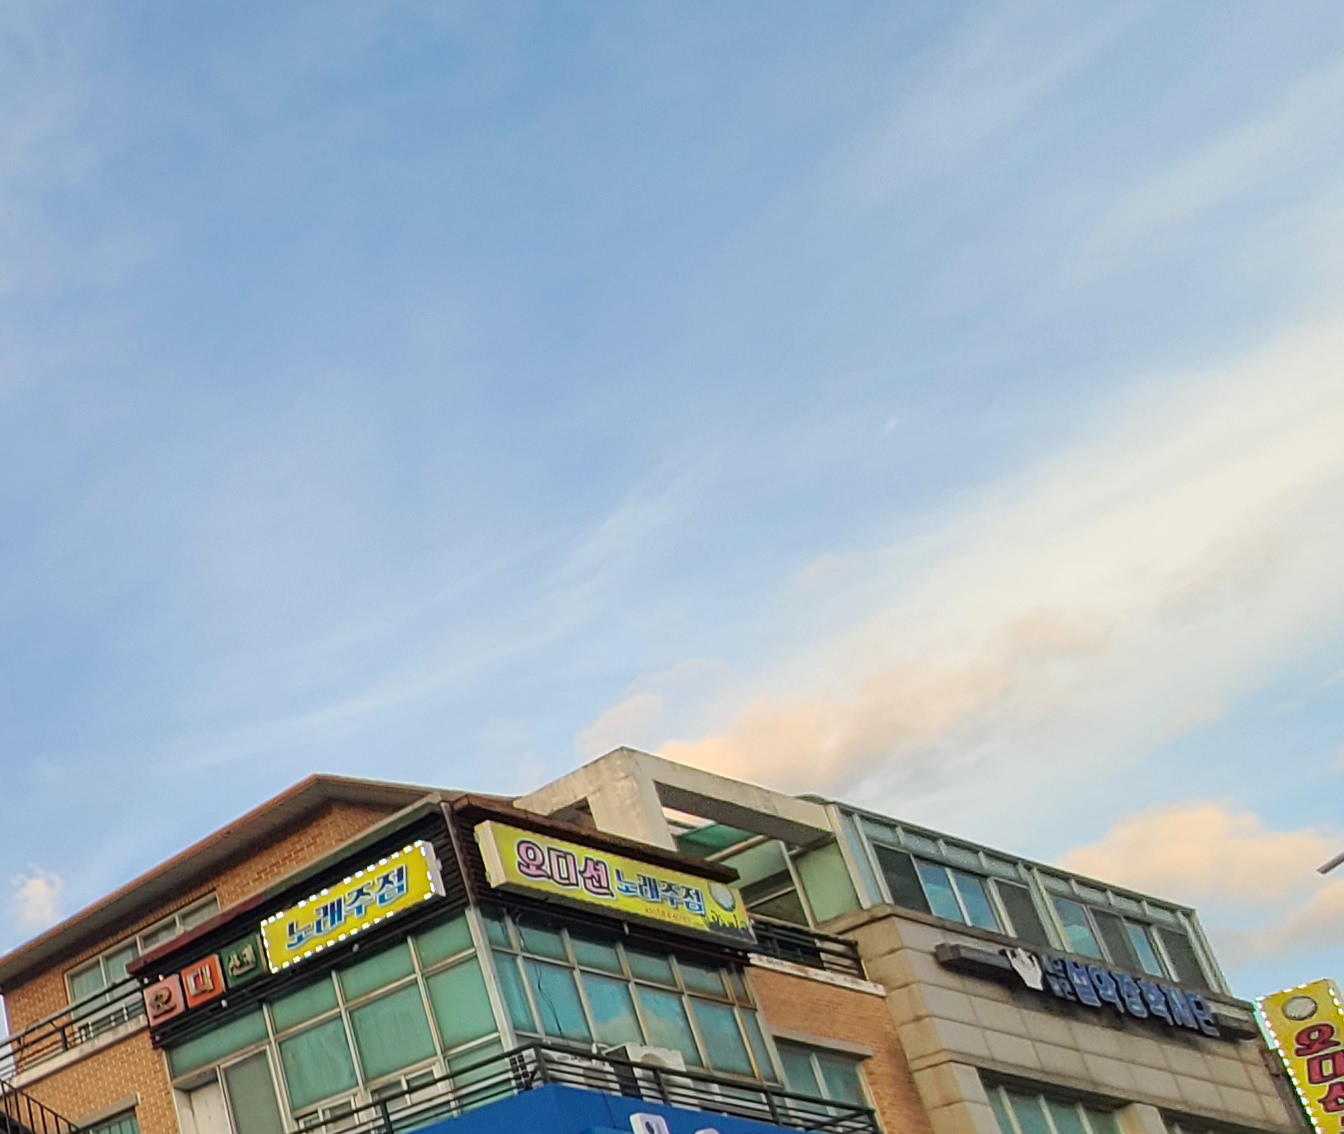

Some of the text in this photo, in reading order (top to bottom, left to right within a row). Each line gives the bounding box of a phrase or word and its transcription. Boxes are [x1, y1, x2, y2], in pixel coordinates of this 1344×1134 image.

[286, 863, 408, 951] 노래주점
[516, 839, 706, 917] 오디션 노래주점
